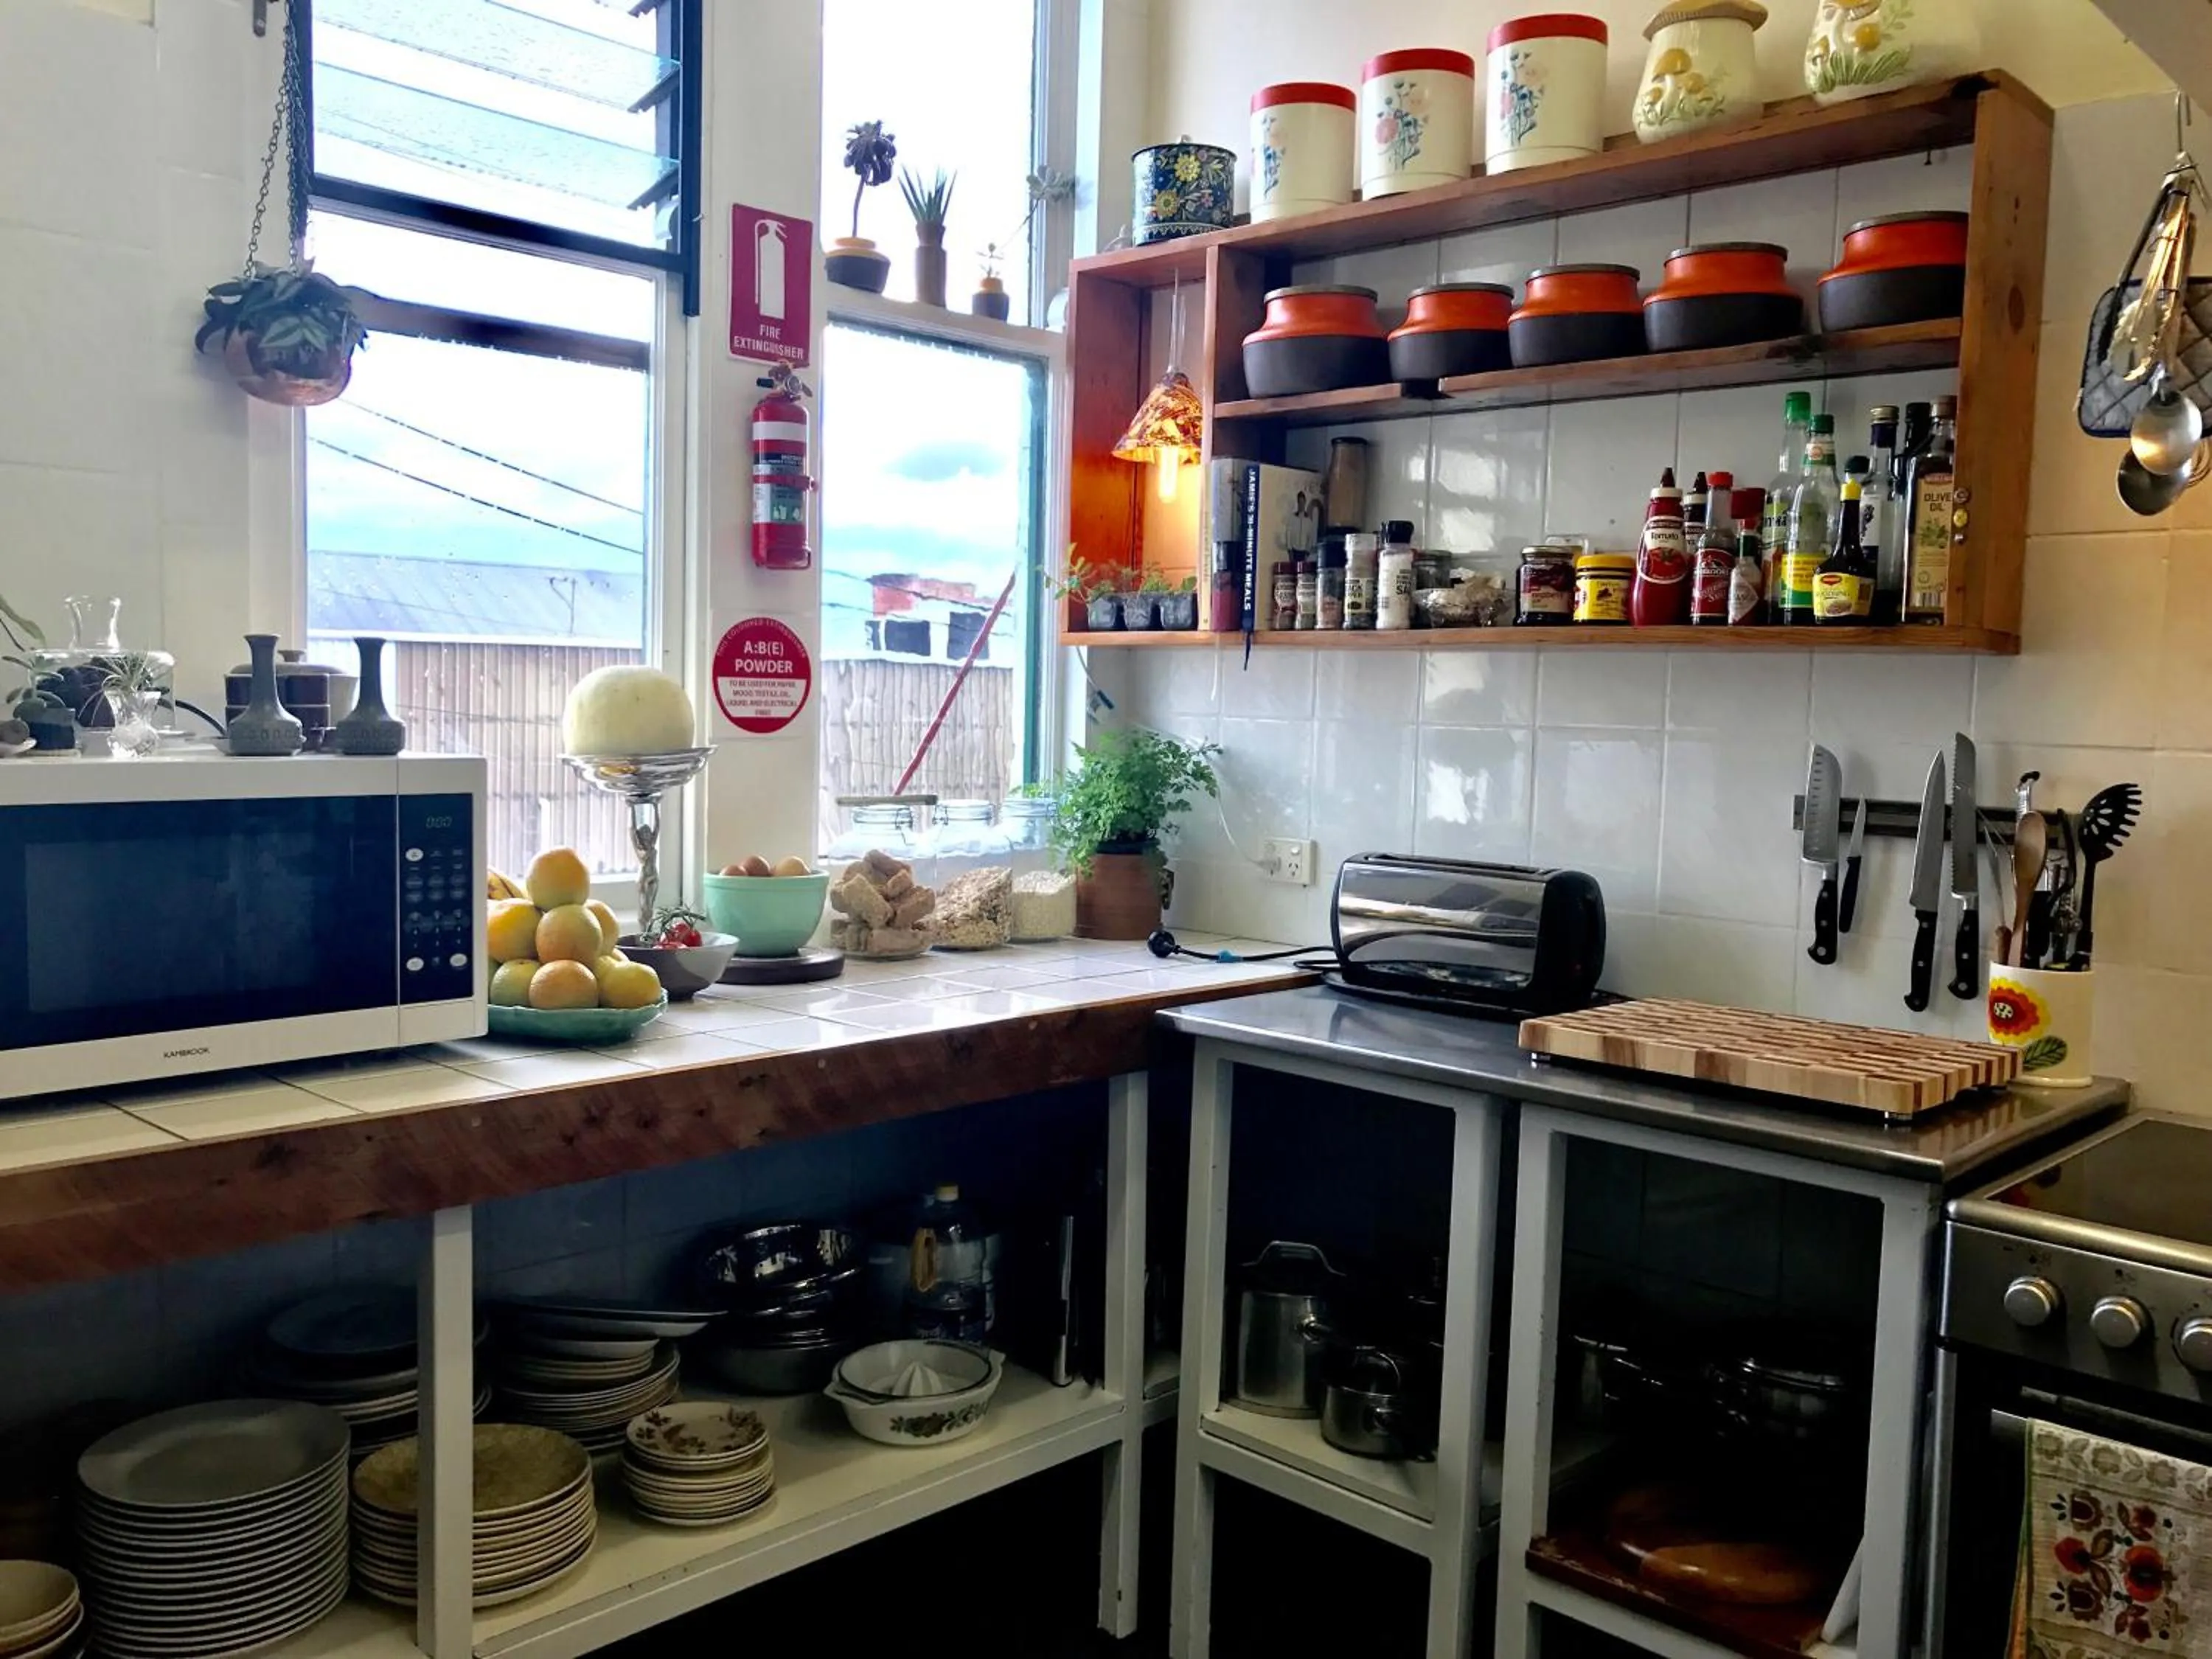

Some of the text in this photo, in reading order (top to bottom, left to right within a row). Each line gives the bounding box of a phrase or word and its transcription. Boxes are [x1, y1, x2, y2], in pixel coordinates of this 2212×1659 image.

[759, 324, 781, 340] FIRE
[734, 336, 804, 359] EXTINGUISHER
[1924, 493, 1952, 503] OLIVE
[1929, 502, 1944, 512] OIL
[1651, 532, 1679, 540] Tomato
[1243, 573, 1253, 611] MEALS
[743, 640, 784, 657] A:B(E)
[734, 658, 793, 674] POWDER
